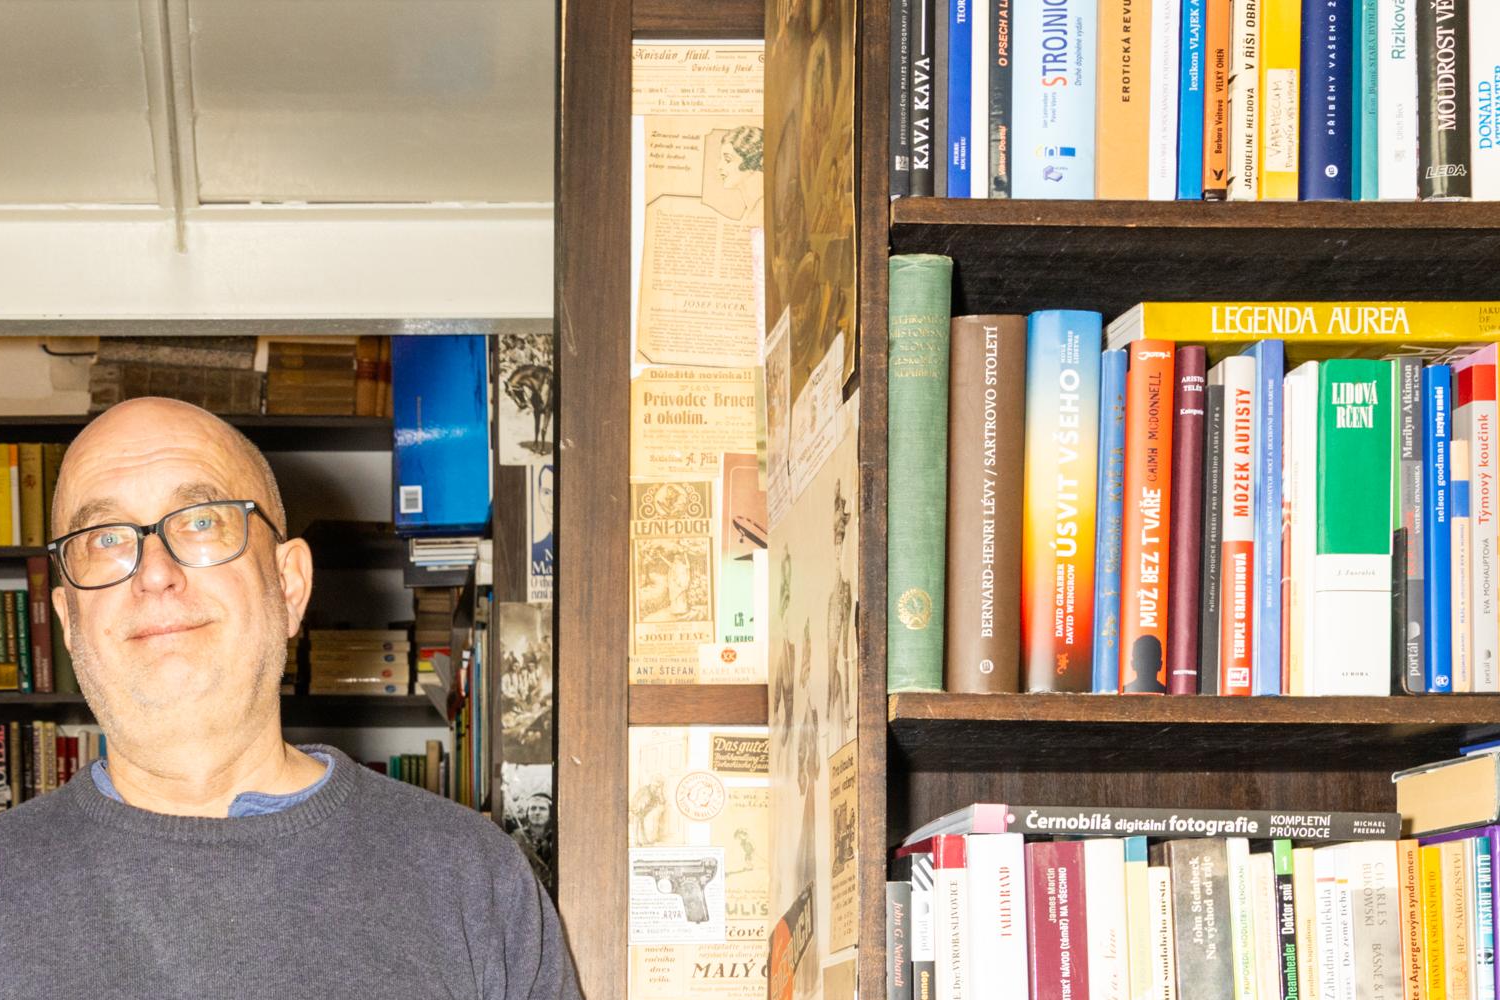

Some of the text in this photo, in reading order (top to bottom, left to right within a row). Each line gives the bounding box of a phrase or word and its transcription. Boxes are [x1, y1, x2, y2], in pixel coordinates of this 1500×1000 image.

[1436, 25, 1457, 131] MOUDROST
[913, 57, 930, 171] KAVA KAVA
[1212, 305, 1410, 335] LEGENDA AUREA
[984, 325, 998, 385] STOLETÍ
[644, 414, 651, 425] a
[1333, 377, 1377, 405] LIDOVÁ
[984, 388, 997, 467] SARTROVO
[1233, 388, 1251, 517] MOZEK AUTISTY
[1048, 368, 1081, 557] ÚSVIT VŠEHO
[1477, 414, 1492, 525] Týmový koučink
[983, 479, 996, 513] LÉVY
[981, 519, 995, 638] BERNARD-HENRI
[1139, 487, 1161, 628] MUŽ BEZ TVÁŘE
[1026, 810, 1258, 835] Černobílá digitální fotografie
[1269, 824, 1330, 837] PRŮVODCE
[1270, 814, 1331, 827] KOMPLETNÍ
[693, 959, 752, 978] MALÝ
